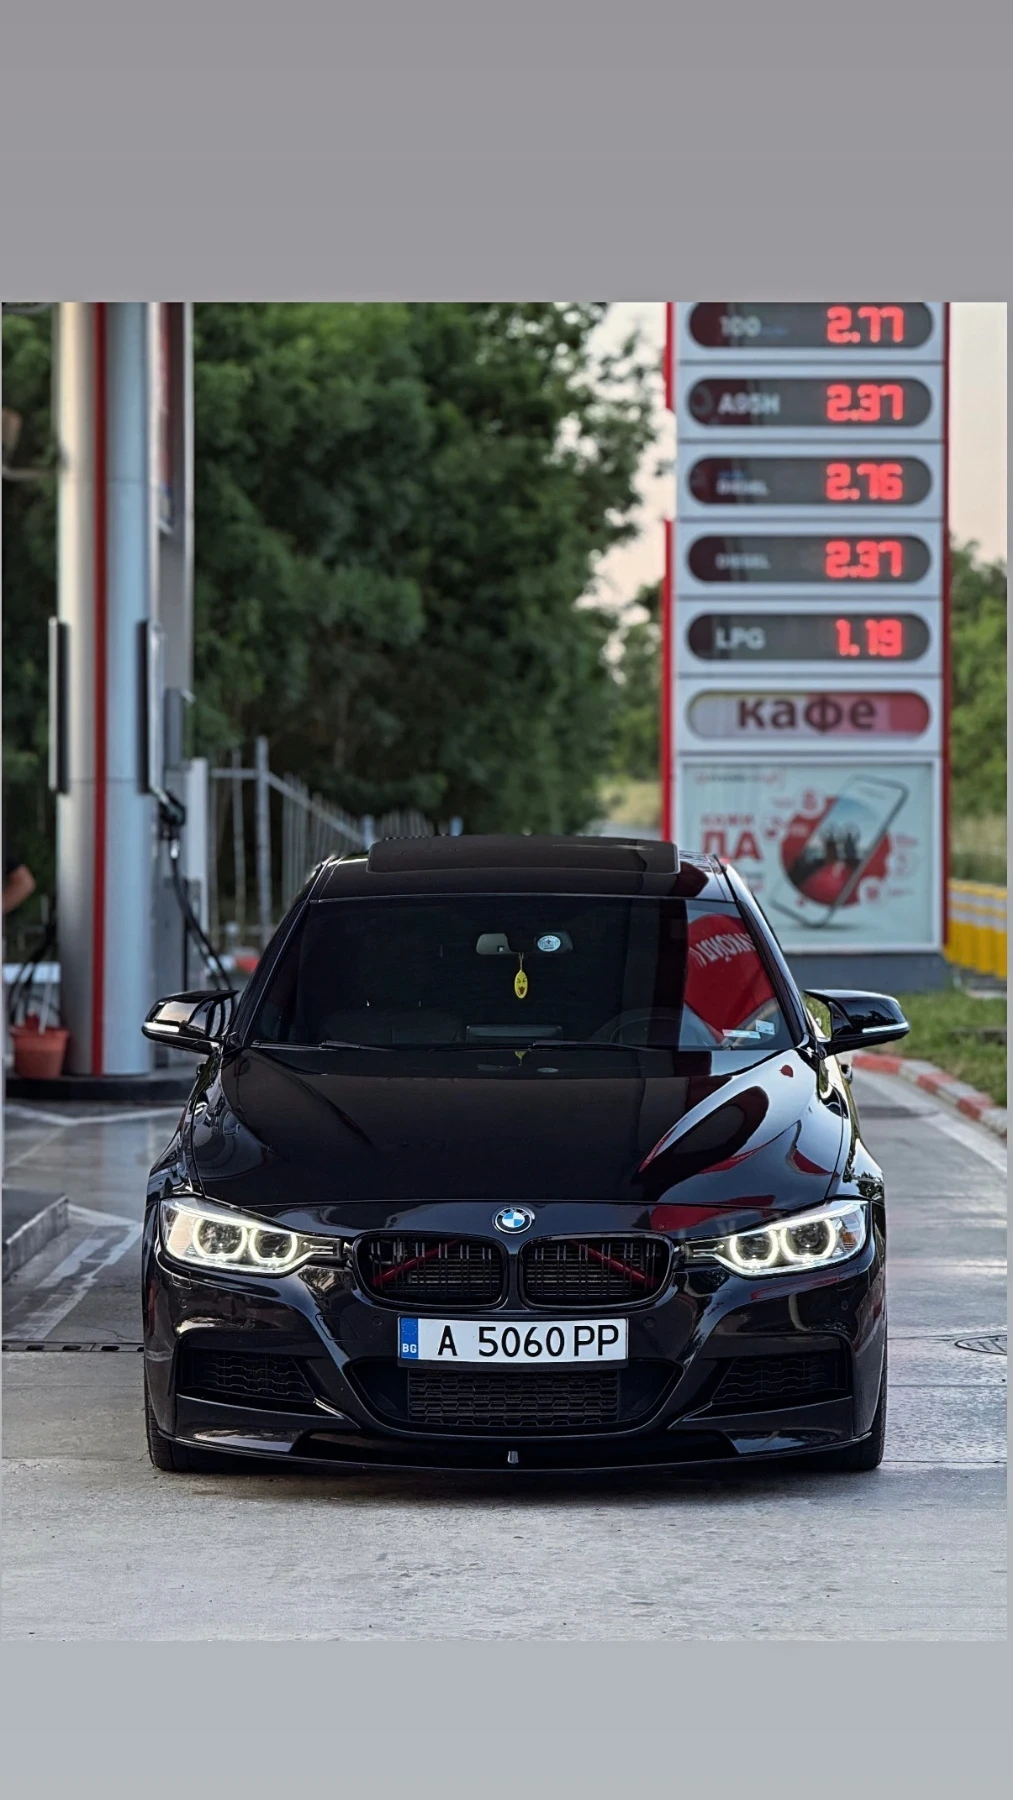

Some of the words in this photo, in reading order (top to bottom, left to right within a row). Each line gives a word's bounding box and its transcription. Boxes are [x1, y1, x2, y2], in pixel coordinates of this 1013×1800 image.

[827, 306, 904, 343] 2.77
[826, 384, 904, 421] 2.37
[826, 463, 903, 500] 2.76
[825, 541, 903, 578] 2.37
[715, 627, 766, 649] LPG
[835, 619, 903, 656] 1.19
[737, 696, 877, 734] кафе
[402, 1343, 417, 1354] BG
[437, 1325, 458, 1356] A
[478, 1326, 565, 1357] 5060
[574, 1324, 619, 1356] PP
